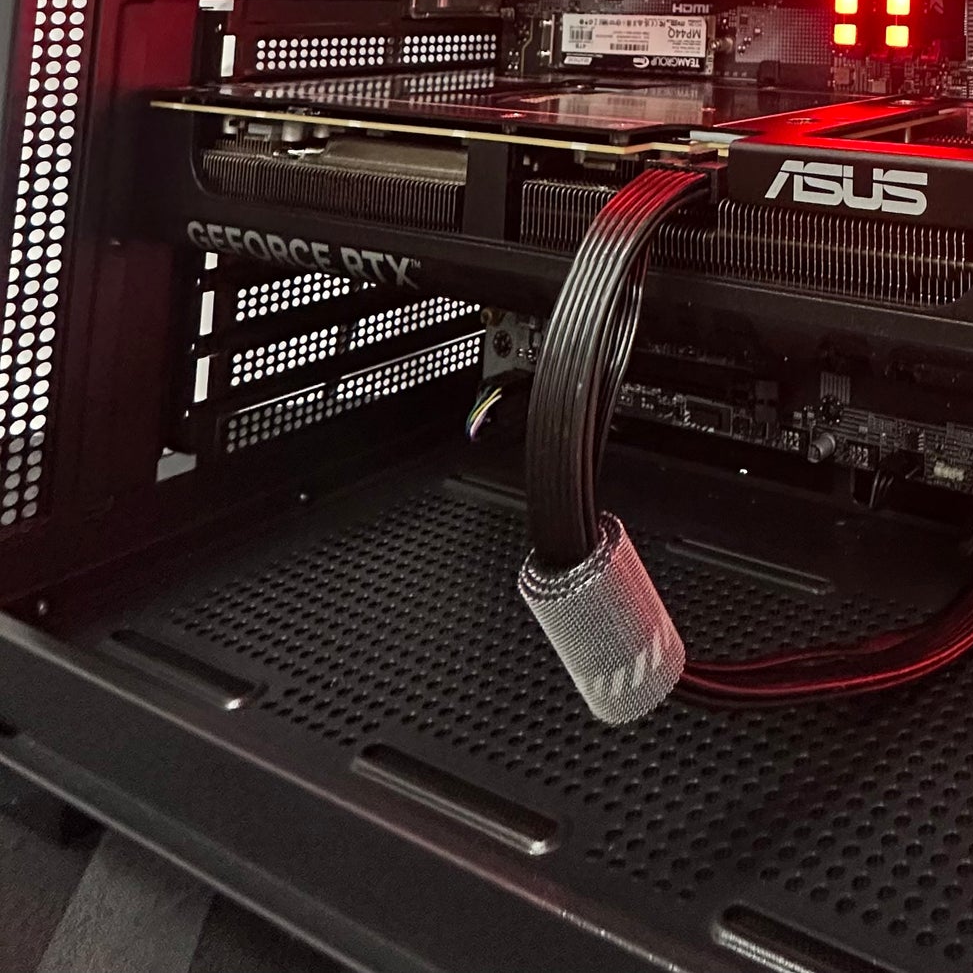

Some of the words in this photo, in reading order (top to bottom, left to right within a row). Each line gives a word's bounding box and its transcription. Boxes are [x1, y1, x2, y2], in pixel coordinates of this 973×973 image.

[672, 3, 710, 13] HDMI
[667, 27, 701, 39] MP44Q
[651, 56, 701, 69] TEAMGROUP
[765, 159, 928, 216] ASUS
[187, 220, 338, 274] GEFORCE
